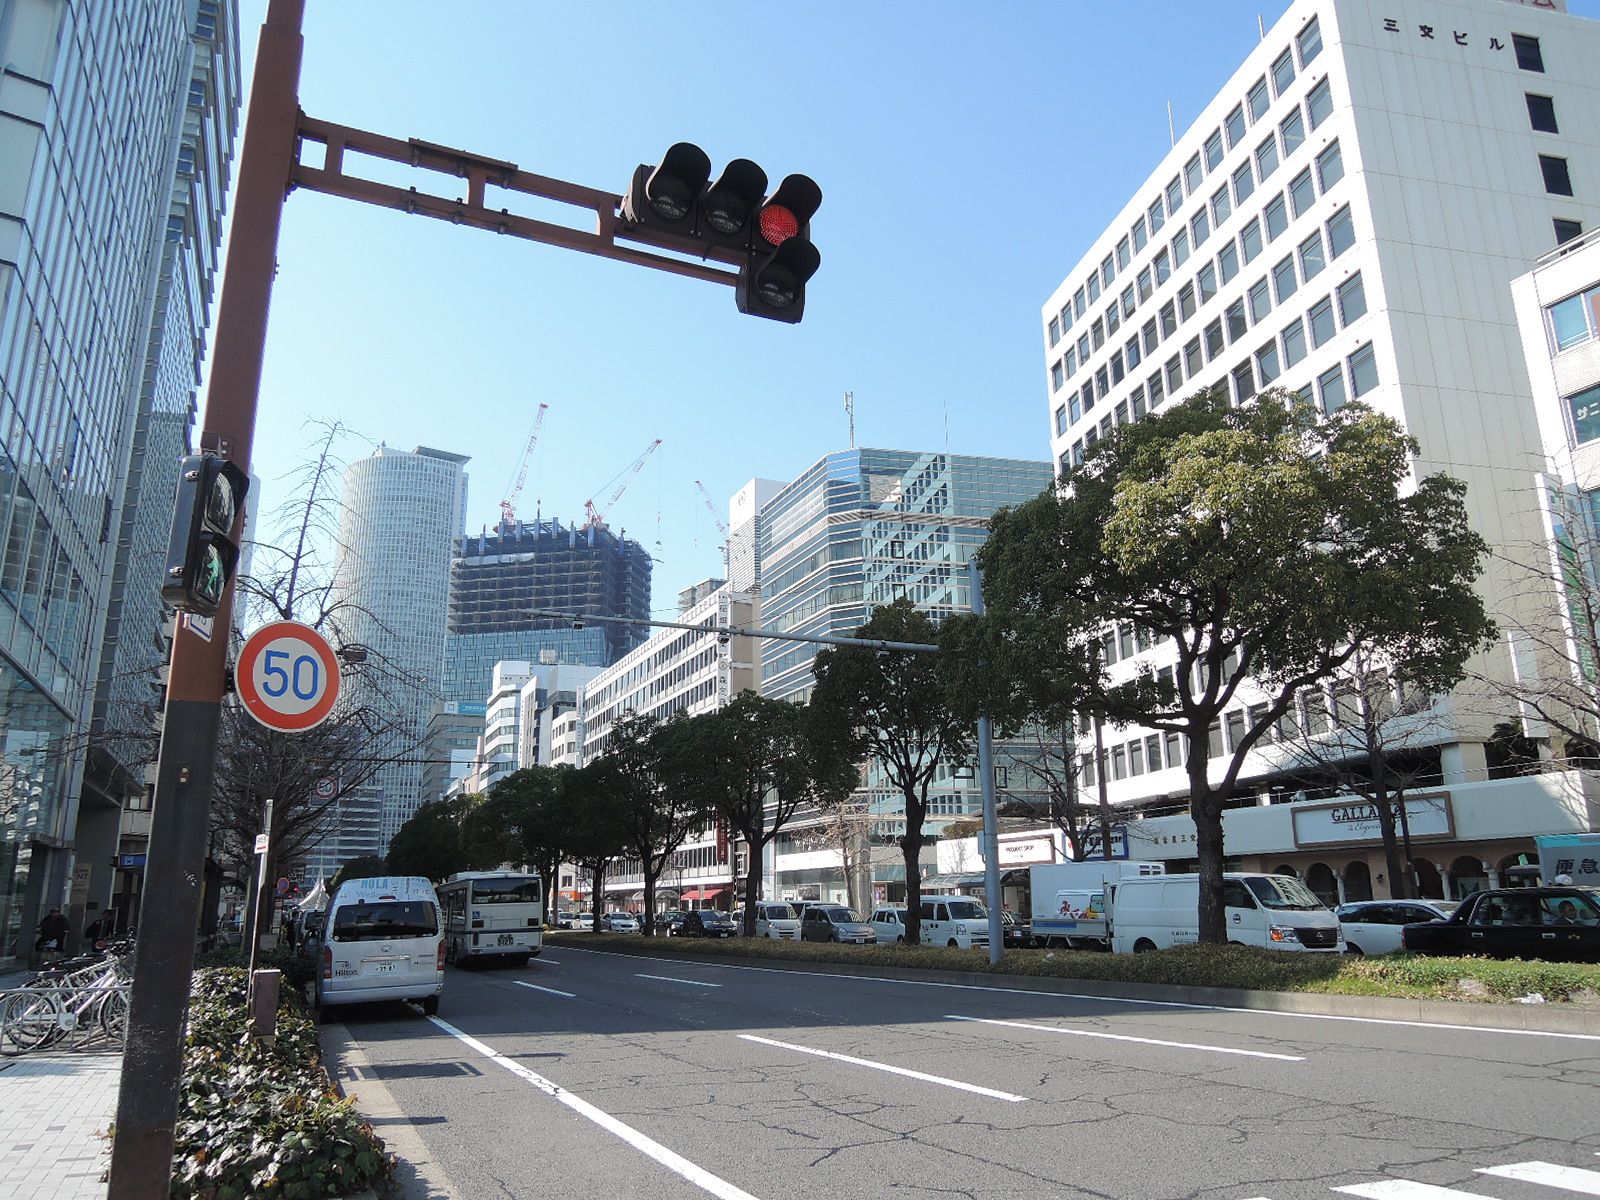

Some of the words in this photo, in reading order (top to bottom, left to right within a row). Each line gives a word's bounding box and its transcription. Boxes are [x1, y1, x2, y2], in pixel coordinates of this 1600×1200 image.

[262, 649, 319, 701] 50
[360, 878, 389, 890] HOLA
[335, 968, 359, 977] Hilton
